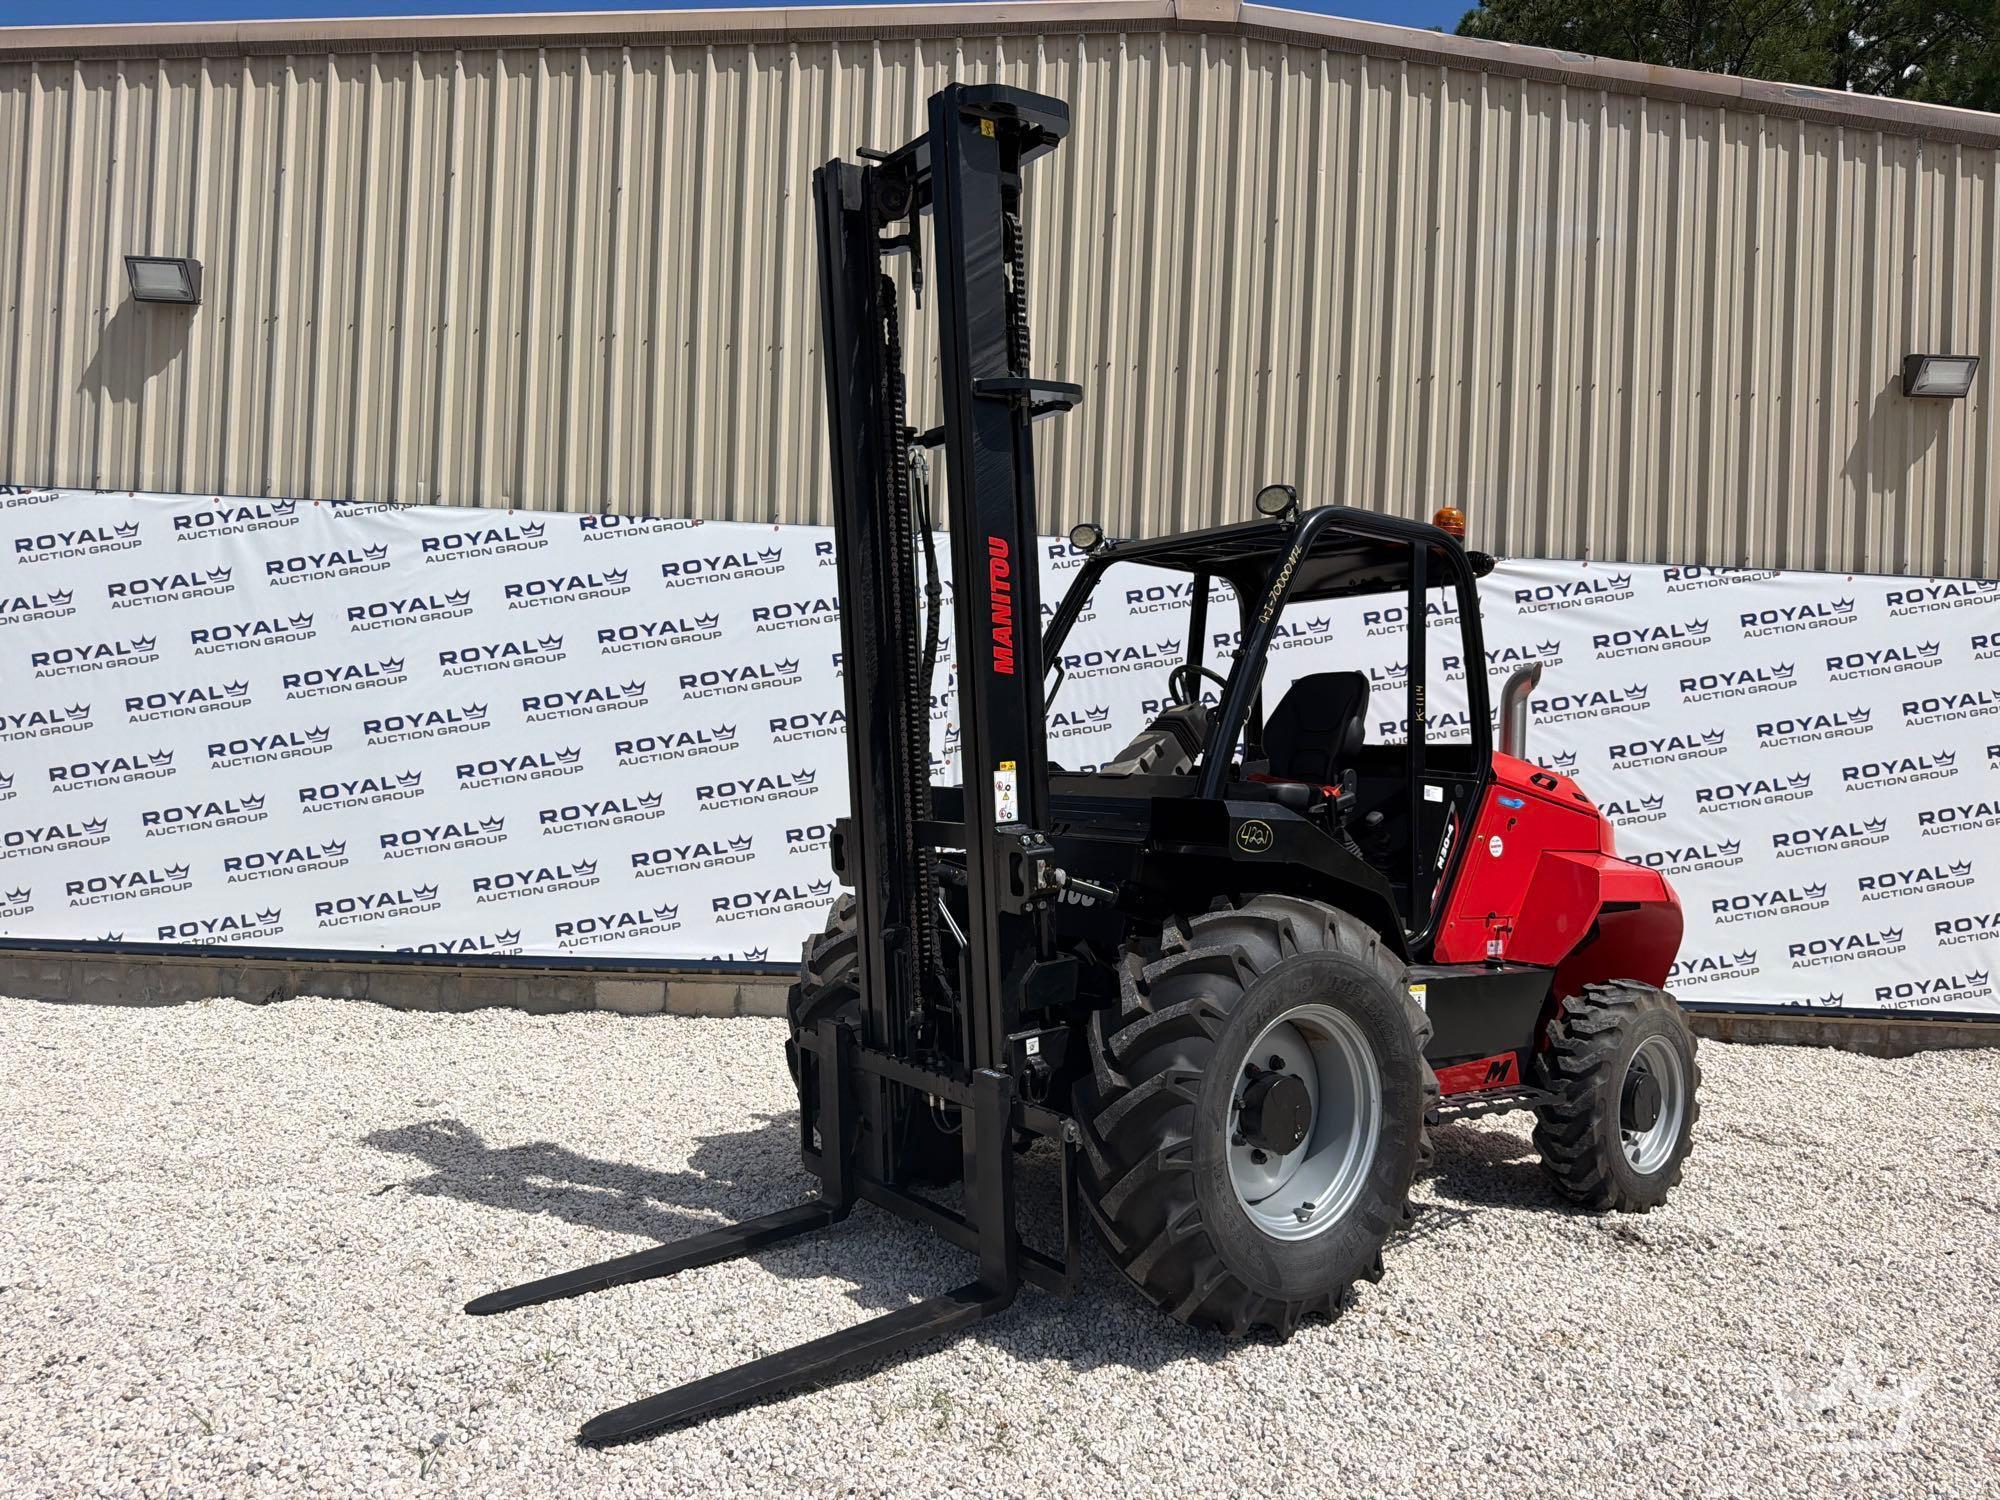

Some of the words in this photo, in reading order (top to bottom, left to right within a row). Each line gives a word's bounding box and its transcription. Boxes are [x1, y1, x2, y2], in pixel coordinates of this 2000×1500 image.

[173, 505, 271, 531] ROYAL
[177, 525, 244, 542] AUCTION
[247, 517, 299, 532] GROUP
[15, 527, 114, 553] ROYAL
[18, 548, 86, 564] AUCTION
[89, 540, 142, 554] GROUP
[421, 527, 520, 553] ROYAL
[425, 547, 492, 564] AUCTION
[495, 540, 548, 554] GROUP
[266, 550, 363, 575] ROYAL
[270, 570, 336, 587] AUCTION
[339, 562, 391, 576] GROUP
[661, 553, 758, 578] ROYAL
[108, 572, 207, 598] ROYAL
[504, 574, 603, 599] ROYAL
[666, 573, 731, 589] AUCTION
[734, 565, 785, 579] GROUP
[112, 593, 179, 609] AUCTION
[182, 585, 235, 599] GROUP
[508, 594, 575, 610] AUCTION
[578, 586, 631, 600] GROUP
[1515, 579, 1608, 604] ROYAL
[1518, 599, 1581, 615] AUCTION
[1584, 591, 1634, 605] GROUP
[347, 595, 445, 622] ROYAL
[989, 536, 1014, 675] MANITOU
[1740, 603, 1832, 628] ROYAL
[191, 619, 289, 645] ROYAL
[351, 616, 417, 632] AUCTION
[420, 608, 473, 622] GROUP
[597, 619, 695, 644] ROYAL
[1744, 623, 1806, 638] AUCTION
[1809, 615, 1857, 629] GROUP
[195, 639, 261, 655] AUCTION
[264, 631, 316, 645] GROUP
[601, 639, 667, 655] AUCTION
[670, 631, 722, 645] GROUP
[1593, 624, 1685, 649] ROYAL
[1596, 644, 1659, 660] AUCTION
[1662, 636, 1711, 650] GROUP
[31, 641, 131, 667] ROYAL
[439, 640, 538, 666] ROYAL
[443, 661, 510, 677] AUCTION
[513, 653, 566, 667] GROUP
[1064, 645, 1157, 670] ROYAL
[1826, 647, 1917, 671] ROYAL
[35, 662, 103, 679] AUCTION
[106, 654, 159, 668] GROUP
[282, 663, 380, 689] ROYAL
[679, 664, 775, 689] ROYAL
[1067, 664, 1130, 680] AUCTION
[1133, 657, 1183, 671] GROUP
[1830, 666, 1891, 682] AUCTION
[1894, 659, 1942, 672] GROUP
[286, 683, 352, 700] AUCTION
[355, 675, 407, 690] GROUP
[683, 684, 748, 700] AUCTION
[751, 676, 802, 690] GROUP
[1679, 668, 1771, 693] ROYAL
[1683, 688, 1745, 703] AUCTION
[1748, 680, 1797, 694] GROUP
[125, 686, 224, 712] ROYAL
[129, 707, 196, 723] AUCTION
[199, 699, 252, 713] GROUP
[522, 686, 621, 712] ROYAL
[526, 706, 593, 723] AUCTION
[596, 698, 648, 713] GROUP
[1531, 690, 1624, 714] ROYAL
[363, 709, 462, 735] ROYAL
[1534, 709, 1598, 725] AUCTION
[1601, 702, 1650, 716] GROUP
[1756, 713, 1848, 738] ROYAL
[208, 732, 305, 758] ROYAL
[367, 729, 434, 746] AUCTION
[437, 721, 491, 736] GROUP
[615, 730, 712, 756] ROYAL
[1760, 733, 1822, 748] AUCTION
[1825, 725, 1873, 739] GROUP
[211, 753, 277, 769] AUCTION
[281, 744, 333, 759] GROUP
[619, 750, 684, 767] AUCTION
[688, 742, 739, 756] GROUP
[1609, 735, 1701, 759] ROYAL
[1612, 754, 1675, 770] AUCTION
[1678, 747, 1727, 760] GROUP
[49, 756, 148, 782] ROYAL
[456, 753, 556, 779] ROYAL
[460, 773, 527, 790] AUCTION
[530, 765, 584, 780] GROUP
[1842, 756, 1933, 781] ROYAL
[52, 776, 120, 793] AUCTION
[123, 768, 176, 782] GROUP
[299, 776, 396, 803] ROYAL
[696, 775, 792, 801] ROYAL
[1696, 778, 1787, 803] ROYAL
[1846, 776, 1907, 792] AUCTION
[1910, 768, 1958, 782] GROUP
[302, 797, 368, 814] AUCTION
[371, 789, 424, 803] GROUP
[539, 798, 638, 824] ROYAL
[700, 795, 764, 811] AUCTION
[768, 787, 819, 801] GROUP
[1699, 798, 1761, 814] AUCTION
[1764, 790, 1813, 804] GROUP
[142, 800, 240, 826] ROYAL
[145, 821, 212, 837] AUCTION
[215, 812, 268, 827] GROUP
[543, 818, 610, 836] AUCTION
[613, 810, 665, 825] GROUP
[380, 822, 479, 849] ROYAL
[384, 843, 451, 860] AUCTION
[454, 834, 507, 849] GROUP
[1437, 823, 1455, 870] M30-4
[1772, 823, 1864, 848] ROYAL
[1776, 843, 1838, 859] AUCTION
[1841, 835, 1889, 849] GROUP
[224, 846, 321, 872] ROYAL
[631, 841, 728, 868] ROYAL
[635, 861, 701, 879] AUCTION
[704, 853, 755, 867] GROUP
[66, 870, 165, 896] ROYAL
[227, 867, 294, 883] AUCTION
[297, 858, 349, 873] GROUP
[473, 866, 572, 892] ROYAL
[1858, 866, 1949, 891] ROYAL
[69, 890, 136, 907] AUCTION
[140, 882, 192, 897] GROUP
[476, 886, 544, 904] AUCTION
[547, 877, 600, 892] GROUP
[712, 886, 808, 912] ROYAL
[1712, 888, 1803, 913] ROYAL
[1862, 886, 1923, 902] AUCTION
[1926, 878, 1975, 892] GROUP
[315, 890, 413, 917] ROYAL
[318, 911, 385, 928] AUCTION
[388, 902, 441, 917] GROUP
[716, 906, 781, 923] AUCTION
[784, 897, 835, 912] GROUP
[1715, 908, 1777, 924] AUCTION
[1780, 900, 1829, 914] GROUP
[555, 910, 654, 938] ROYAL
[558, 931, 625, 949] AUCTION
[628, 922, 681, 937] GROUP
[1789, 933, 1880, 958] ROYAL
[1792, 953, 1854, 969] AUCTION
[1857, 945, 1906, 959] GROUP
